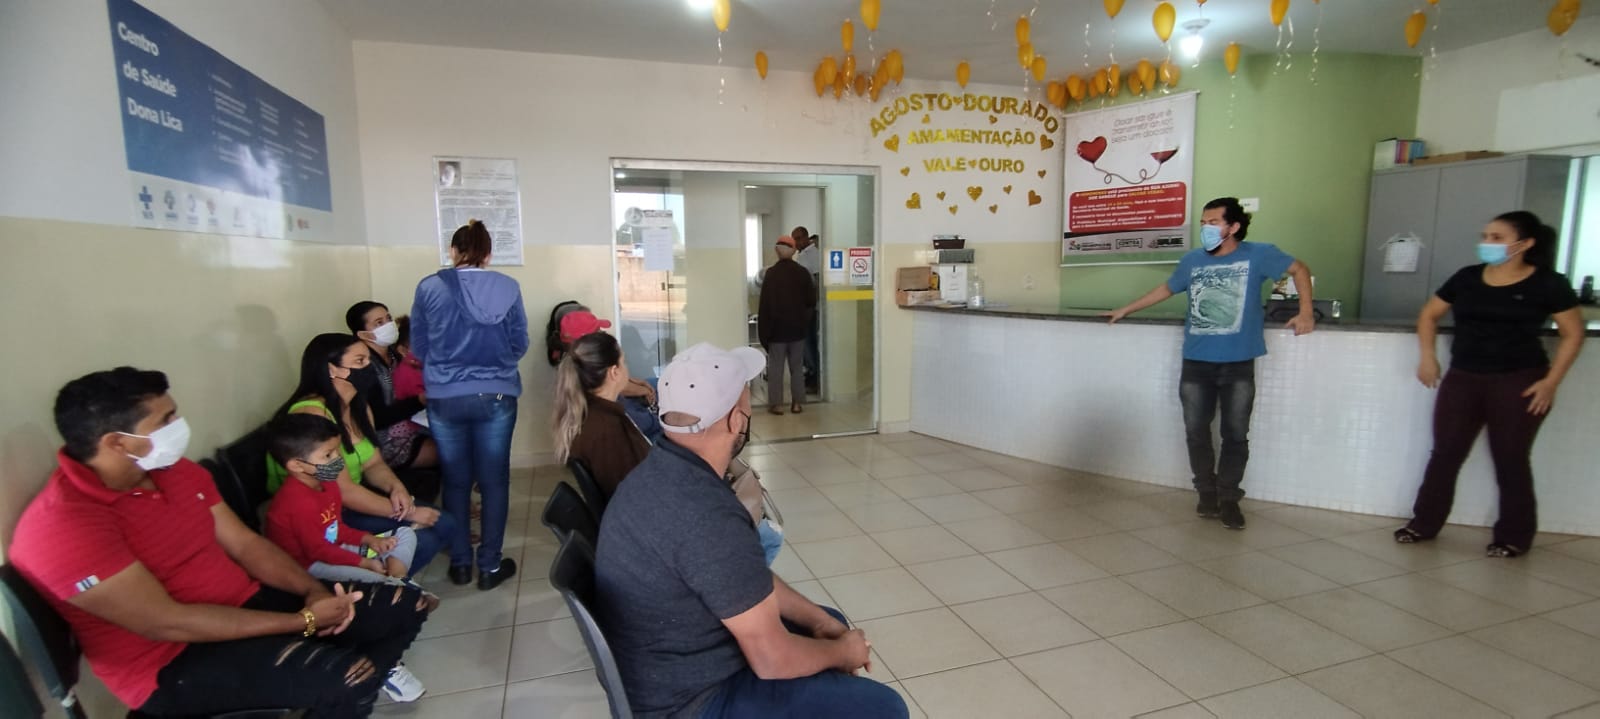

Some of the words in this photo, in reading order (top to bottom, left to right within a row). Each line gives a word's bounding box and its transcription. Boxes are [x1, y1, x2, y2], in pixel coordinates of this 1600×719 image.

[117, 22, 160, 56] Centro
[122, 61, 140, 82] de
[141, 69, 177, 97] Saúde
[128, 97, 160, 125] Dona
[160, 109, 184, 133] Lica
[869, 92, 953, 138] AGOSTO
[962, 93, 1059, 134] DOURADO
[907, 128, 1036, 148] AMAMENTAÇÃO
[922, 157, 967, 174] VALE
[978, 157, 1025, 174] OURO
